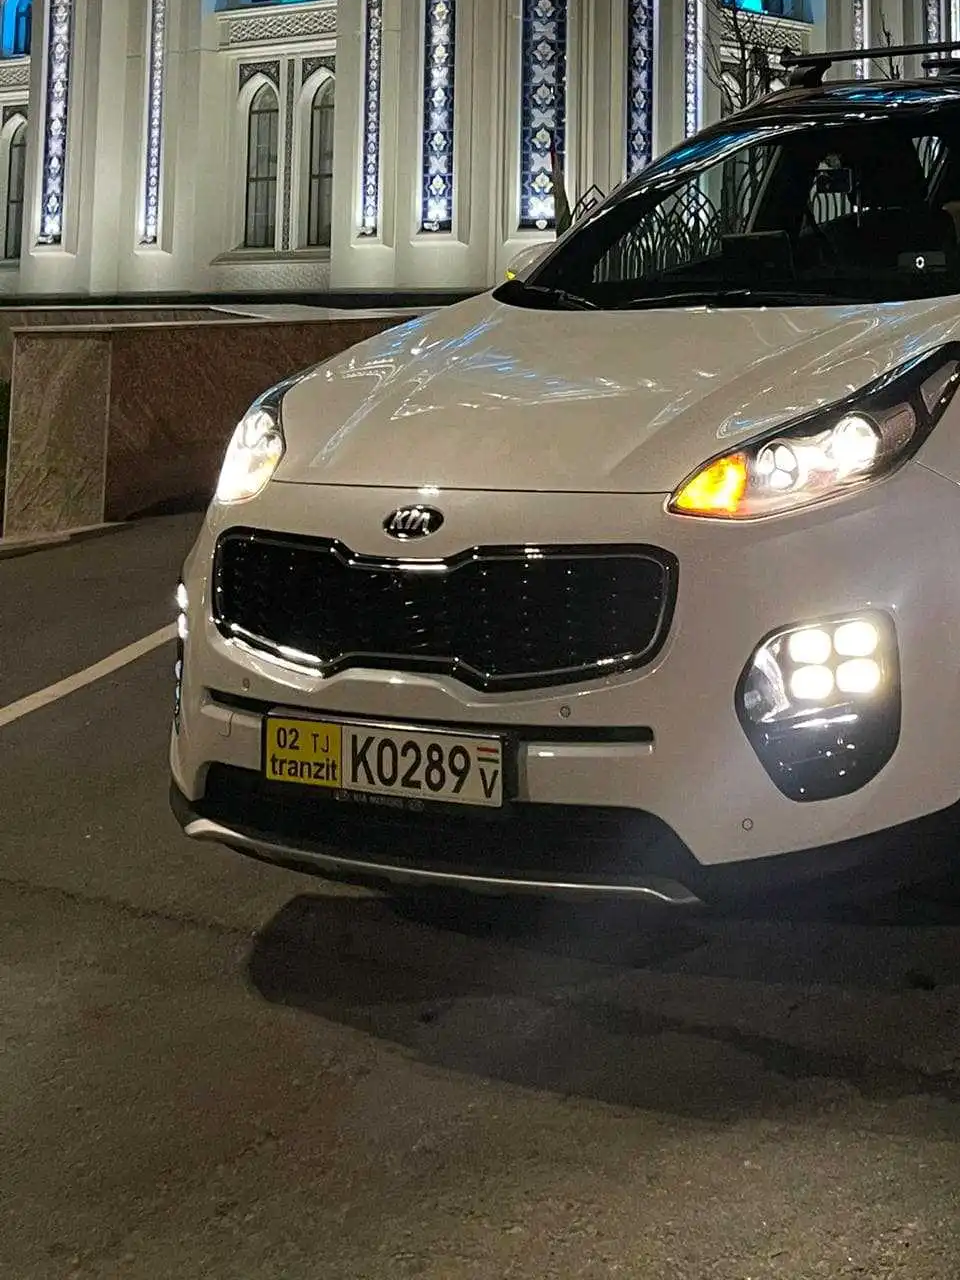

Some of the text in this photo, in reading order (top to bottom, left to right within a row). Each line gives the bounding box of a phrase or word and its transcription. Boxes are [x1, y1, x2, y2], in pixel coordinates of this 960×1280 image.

[390, 509, 430, 533] KIA
[276, 727, 329, 754] 02 TJ
[270, 753, 337, 781] tranzit
[351, 734, 499, 799] K0289 V
